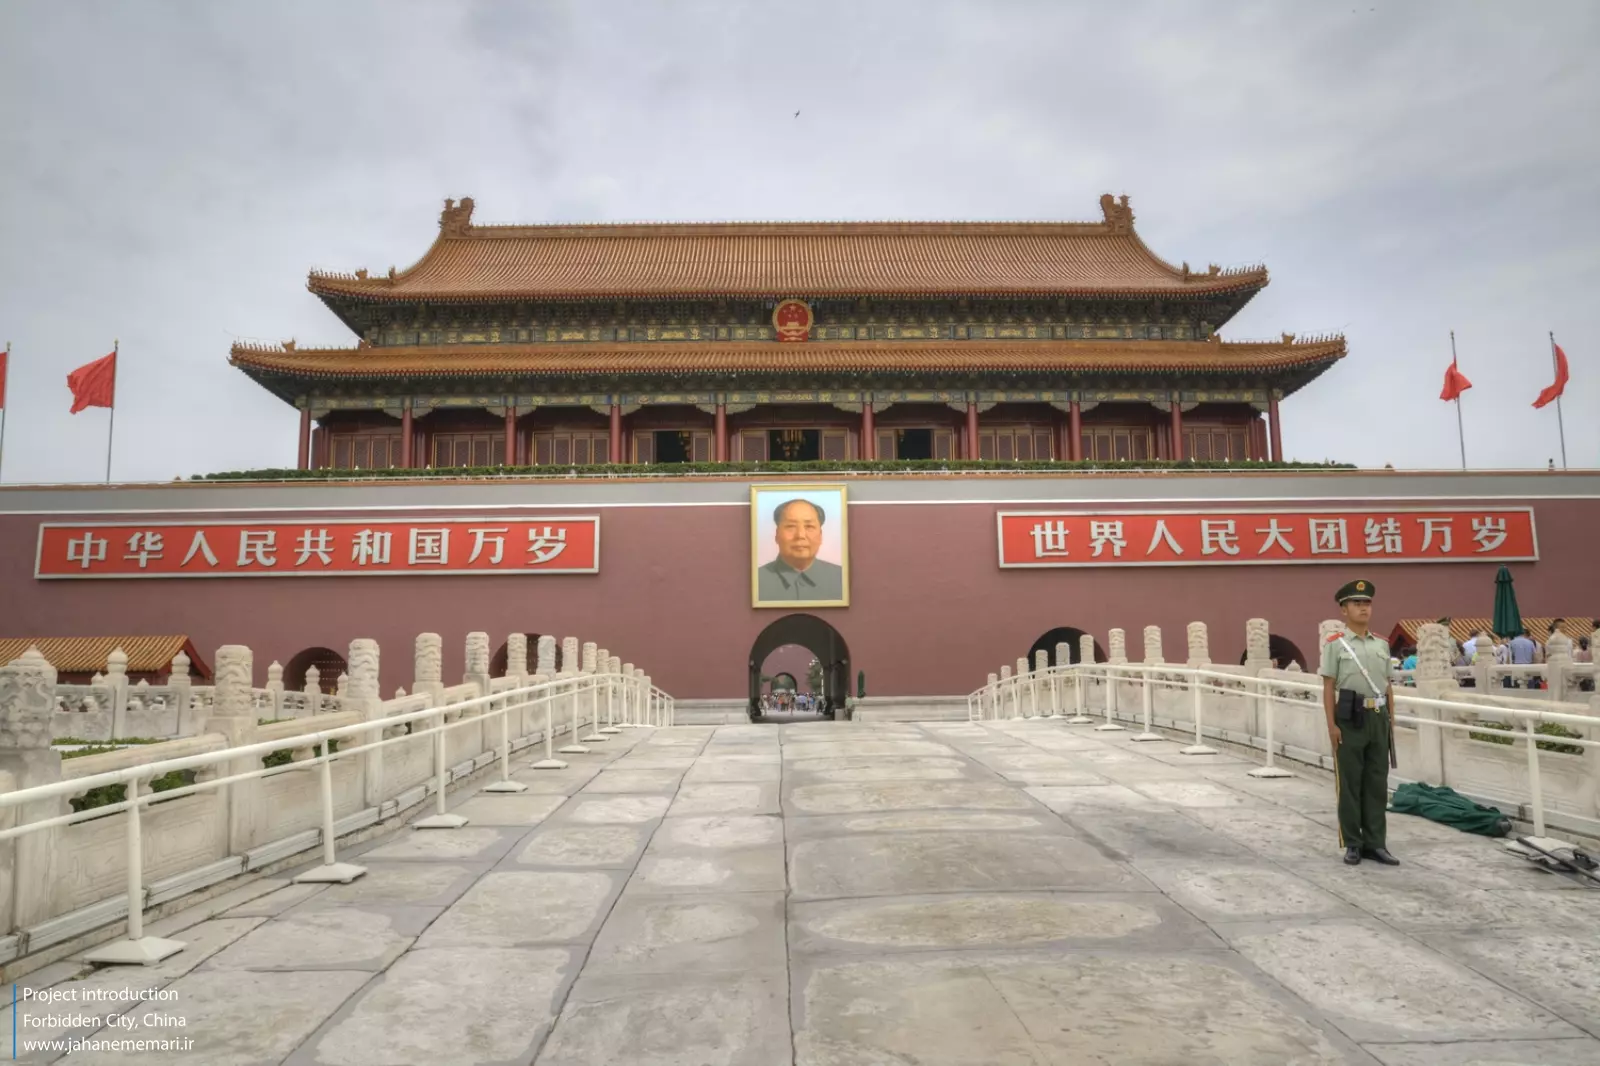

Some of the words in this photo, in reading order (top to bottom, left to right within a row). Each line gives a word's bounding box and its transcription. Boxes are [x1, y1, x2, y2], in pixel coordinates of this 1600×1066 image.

[66, 527, 568, 569] 中华人民共和国万岁
[1029, 516, 1509, 558] 世界人民大团结万岁
